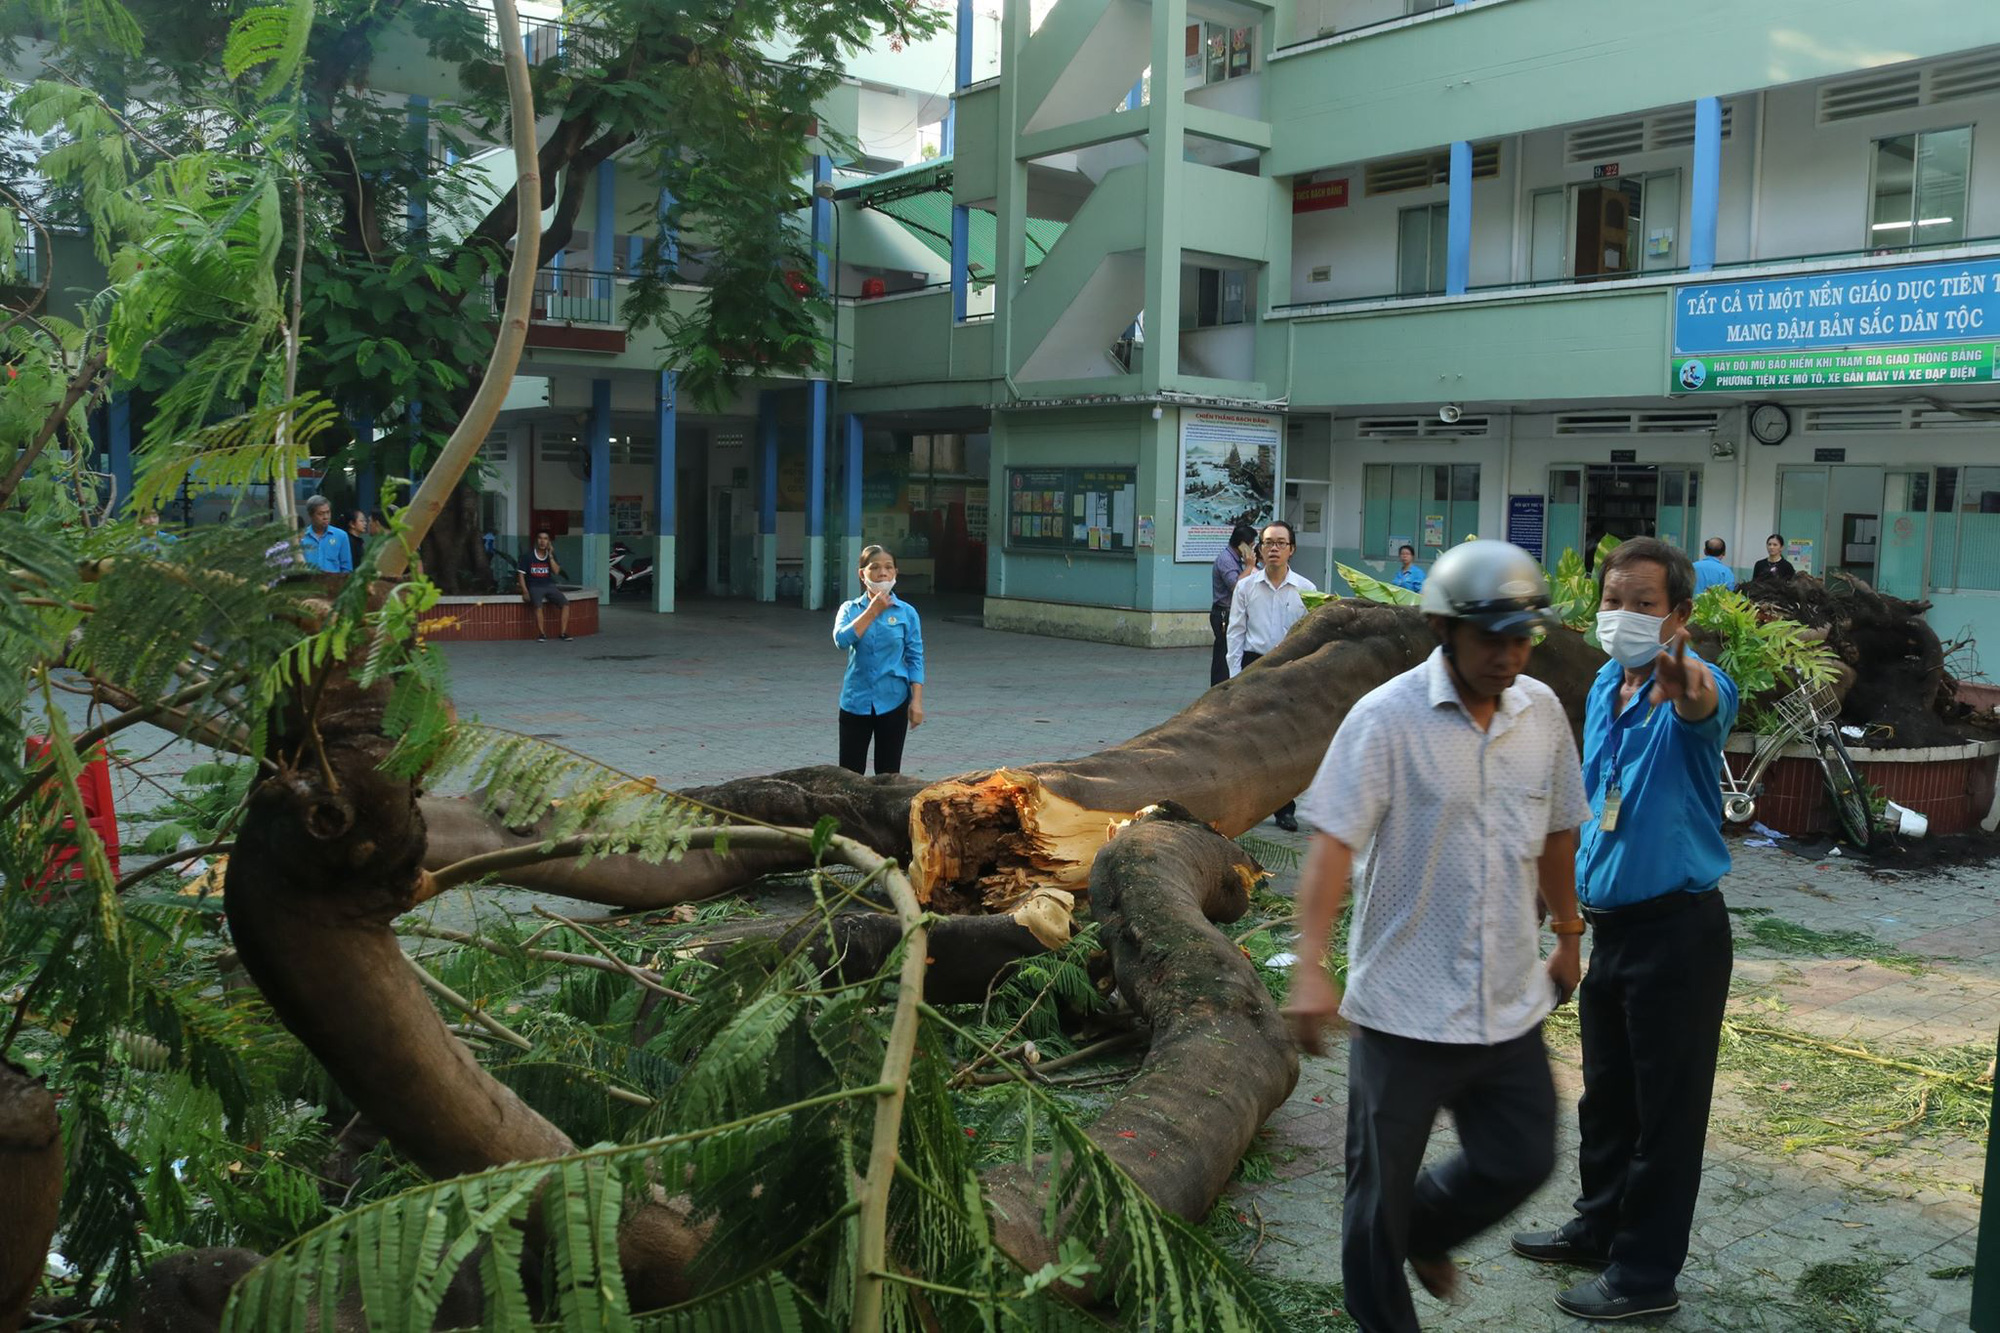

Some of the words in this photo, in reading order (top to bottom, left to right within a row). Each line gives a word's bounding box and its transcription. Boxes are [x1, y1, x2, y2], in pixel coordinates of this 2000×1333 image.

[1687, 290, 1717, 315] TẤT
[1722, 289, 1742, 313] CẢ
[1748, 288, 1764, 311] VÌ
[1768, 286, 1804, 313] MỘT
[1808, 280, 1844, 306] NỀN
[1848, 279, 1892, 304] GIÁO
[1897, 280, 1936, 304] DỤC
[1940, 272, 1986, 296] TIÊN
[1727, 323, 1772, 342] MANG
[1778, 317, 1814, 344] ĐẬM
[1820, 312, 1854, 338] BẢN
[1860, 306, 1894, 336] SẮC
[1900, 308, 1939, 332] DÂN
[1944, 305, 1984, 334] TỘC
[1816, 358, 1832, 368] KHI
[1836, 356, 1862, 367] THAM
[1866, 355, 1882, 366] GIA
[1886, 354, 1910, 365] GIAO
[1914, 350, 1948, 364] THÔNG
[1756, 374, 1776, 388] TIỆN
[1778, 374, 1790, 384] XE
[1793, 372, 1808, 384] MÔ
[1828, 372, 1840, 383] XE
[1892, 367, 1906, 381] VÀ
[1908, 369, 1922, 380] XE
[1925, 368, 1946, 382] ĐẠP
[1950, 365, 1976, 380] ĐIỆN
